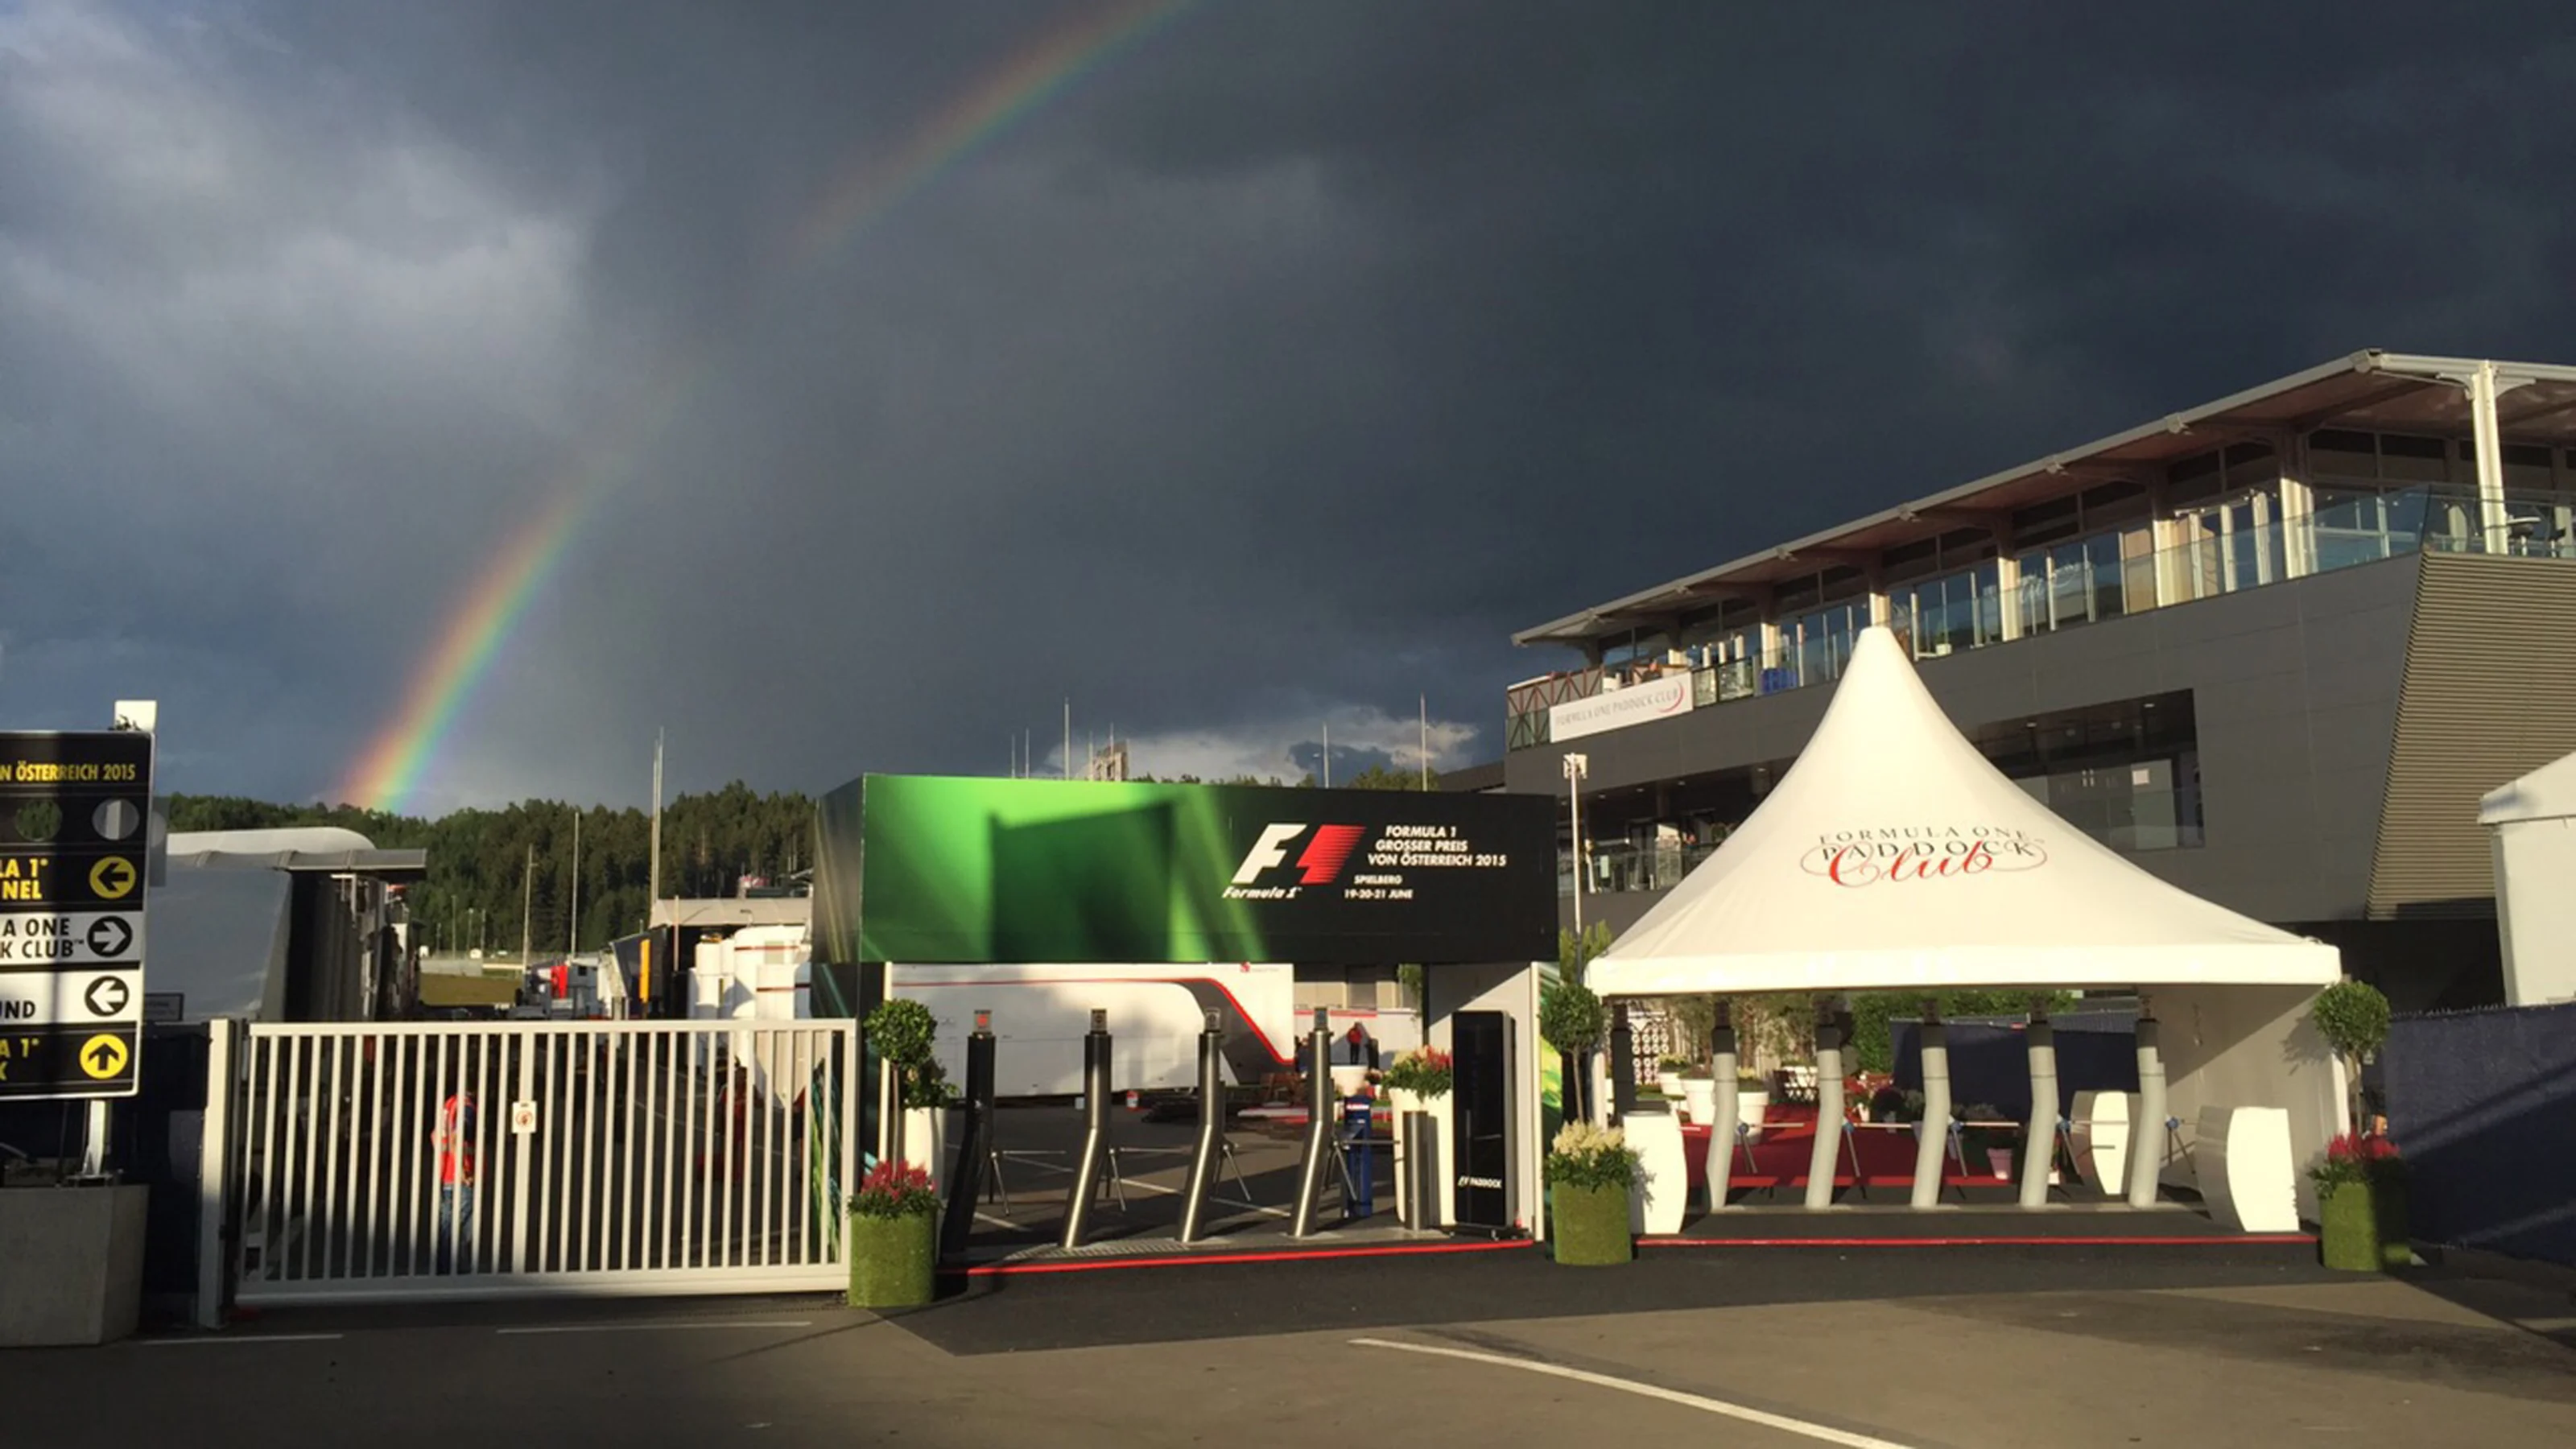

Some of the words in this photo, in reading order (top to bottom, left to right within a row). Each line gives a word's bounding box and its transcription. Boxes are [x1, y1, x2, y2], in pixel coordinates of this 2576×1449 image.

[16, 760, 98, 781] ÖSTERREICH
[103, 763, 136, 781] 2015
[1385, 825, 1446, 838] FORMULA
[1448, 826, 1457, 838] 1
[1818, 826, 1961, 845] FORMULA
[1375, 840, 1432, 852] GROSSER
[1435, 840, 1468, 852] PREIS
[1823, 840, 2036, 861] PADDOCK
[1368, 853, 1398, 866] VON
[1400, 850, 1473, 866] ÖSTERREICH
[1476, 854, 1507, 867] 2015
[1828, 840, 1994, 887] Club
[1353, 874, 1403, 886] SPIELBERG
[1222, 886, 1283, 899] Formula
[1344, 889, 1386, 899] 19-20-21
[1388, 889, 1414, 899] JUNE
[25, 918, 70, 937] ONE
[0, 1000, 35, 1019] ND
